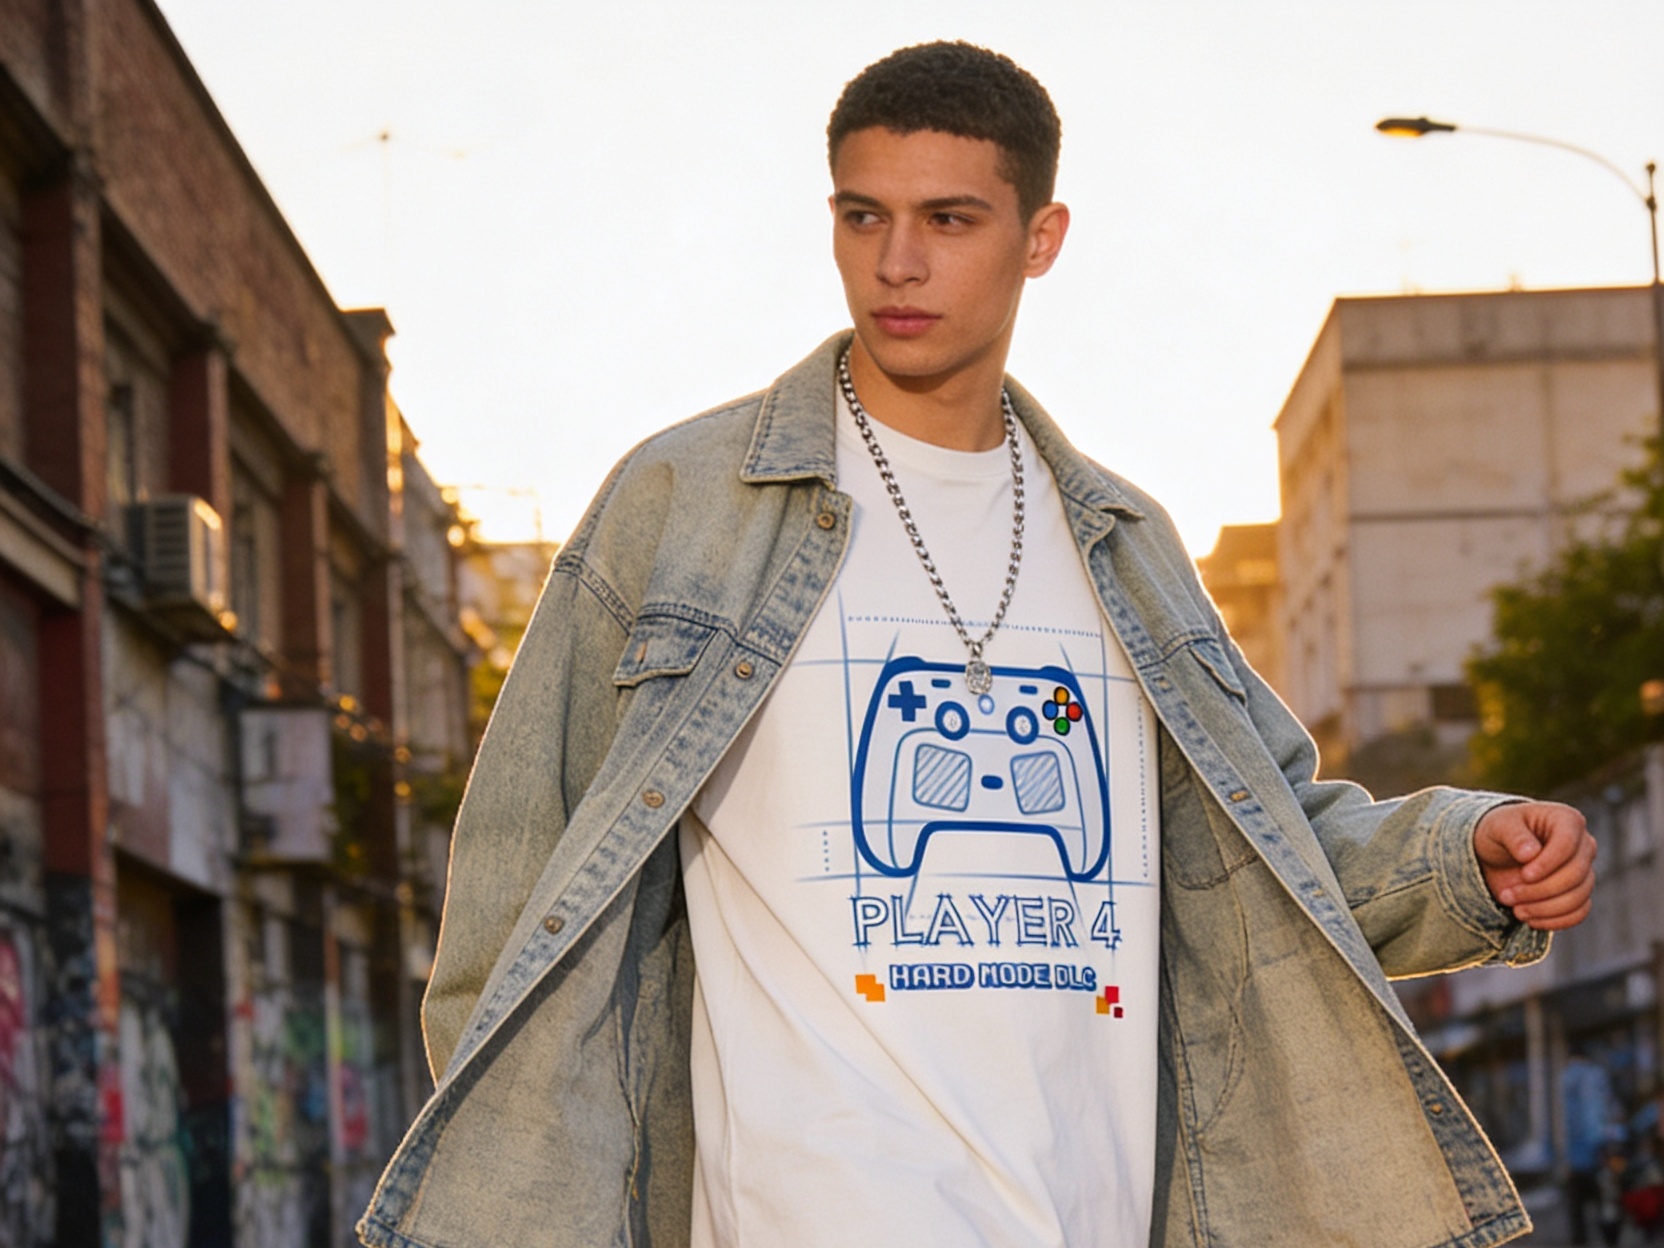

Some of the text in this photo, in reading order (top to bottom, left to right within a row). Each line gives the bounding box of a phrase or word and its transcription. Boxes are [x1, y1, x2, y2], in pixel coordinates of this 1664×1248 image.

[850, 893, 1122, 950] PLAYER 4
[889, 962, 1097, 991] HARD MODE DLC
